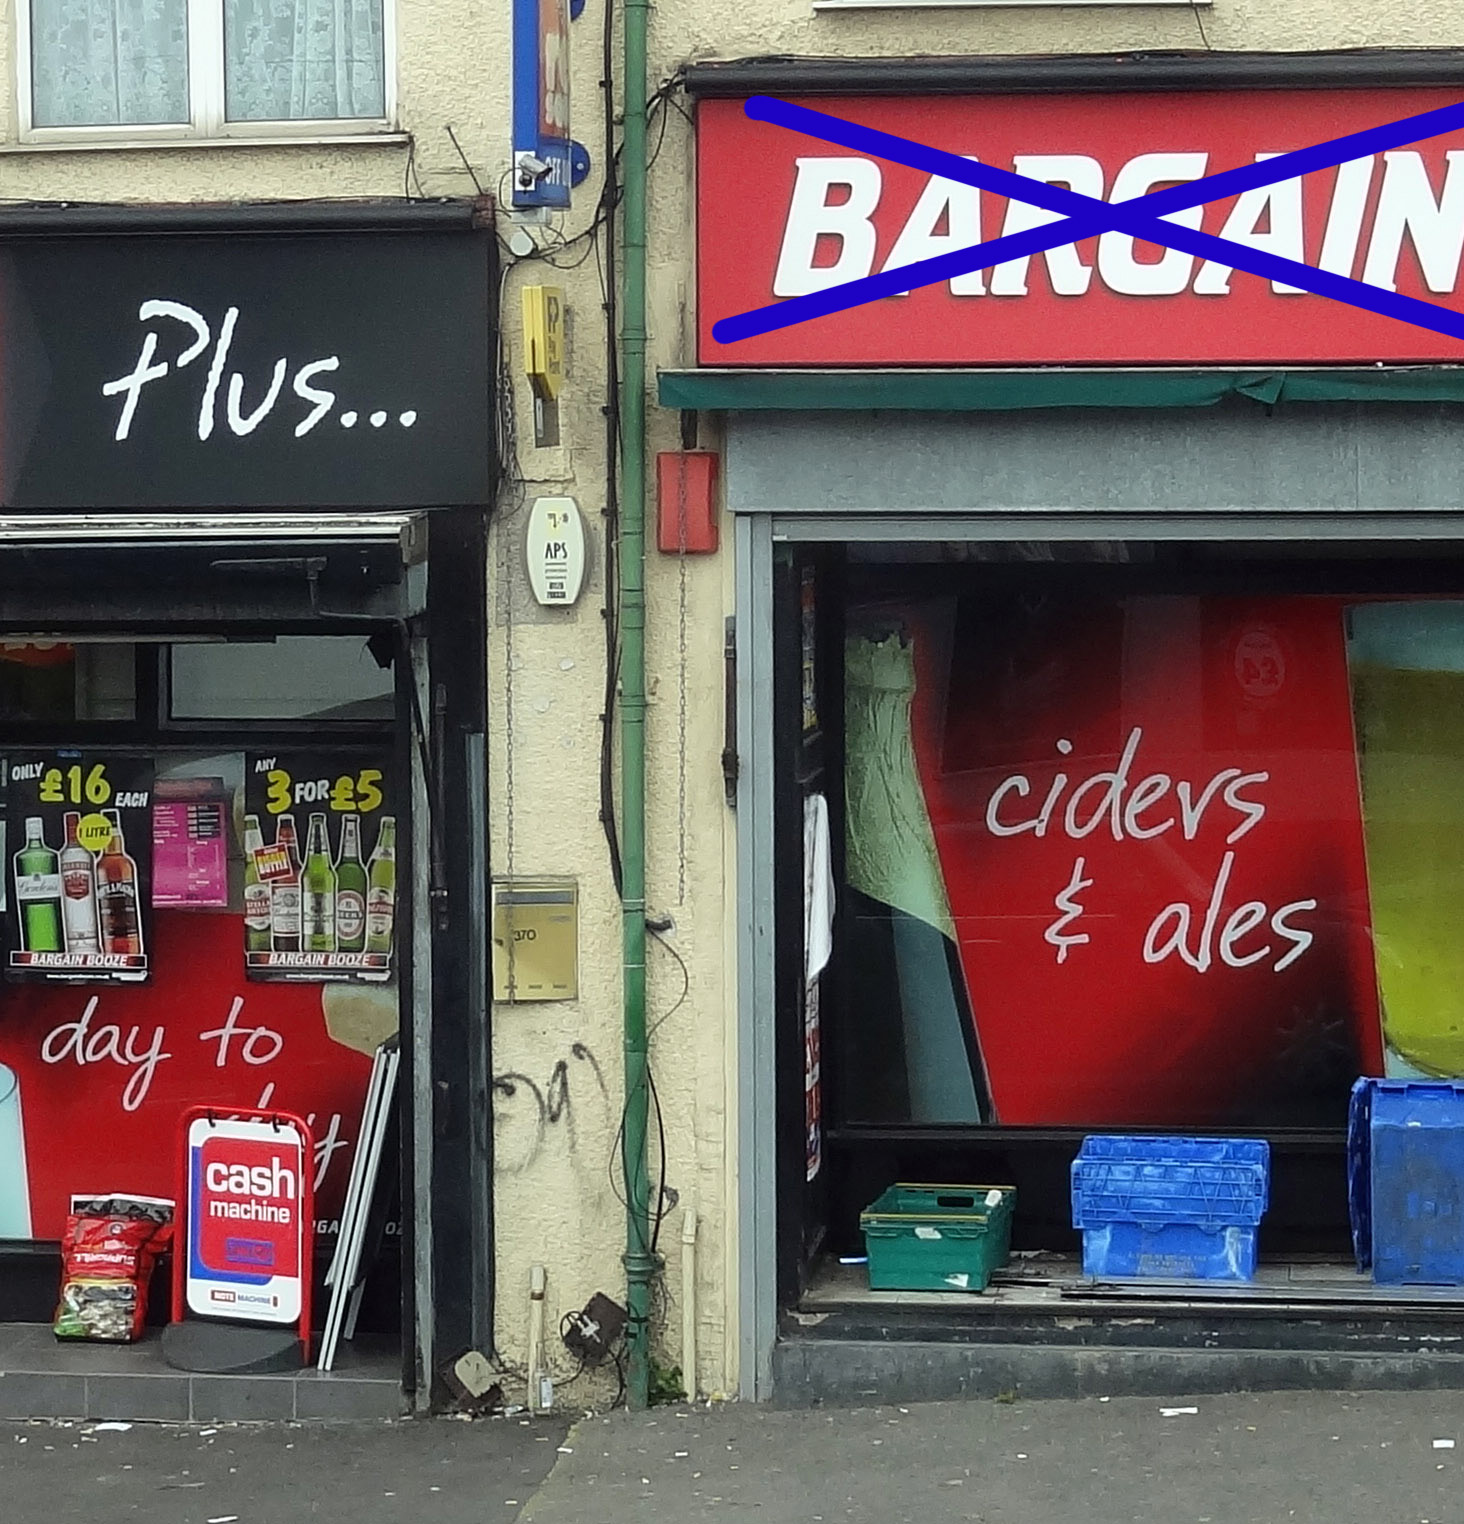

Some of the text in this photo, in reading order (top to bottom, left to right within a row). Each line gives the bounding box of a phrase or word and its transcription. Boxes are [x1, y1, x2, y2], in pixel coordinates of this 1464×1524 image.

[545, 541, 568, 559] APS
[11, 762, 149, 808] ONLY £16 EACH
[255, 757, 383, 814] ANY 3 FOR £5
[985, 727, 1269, 845] ciders
[85, 825, 112, 839] LITRE
[1141, 850, 1318, 974] ales
[29, 952, 129, 967] BARGAIN BOOZE
[268, 952, 371, 967] BARGAIN BOOZE
[40, 994, 284, 1112] day to
[205, 1156, 296, 1200] cash
[209, 1199, 291, 1224] machine
